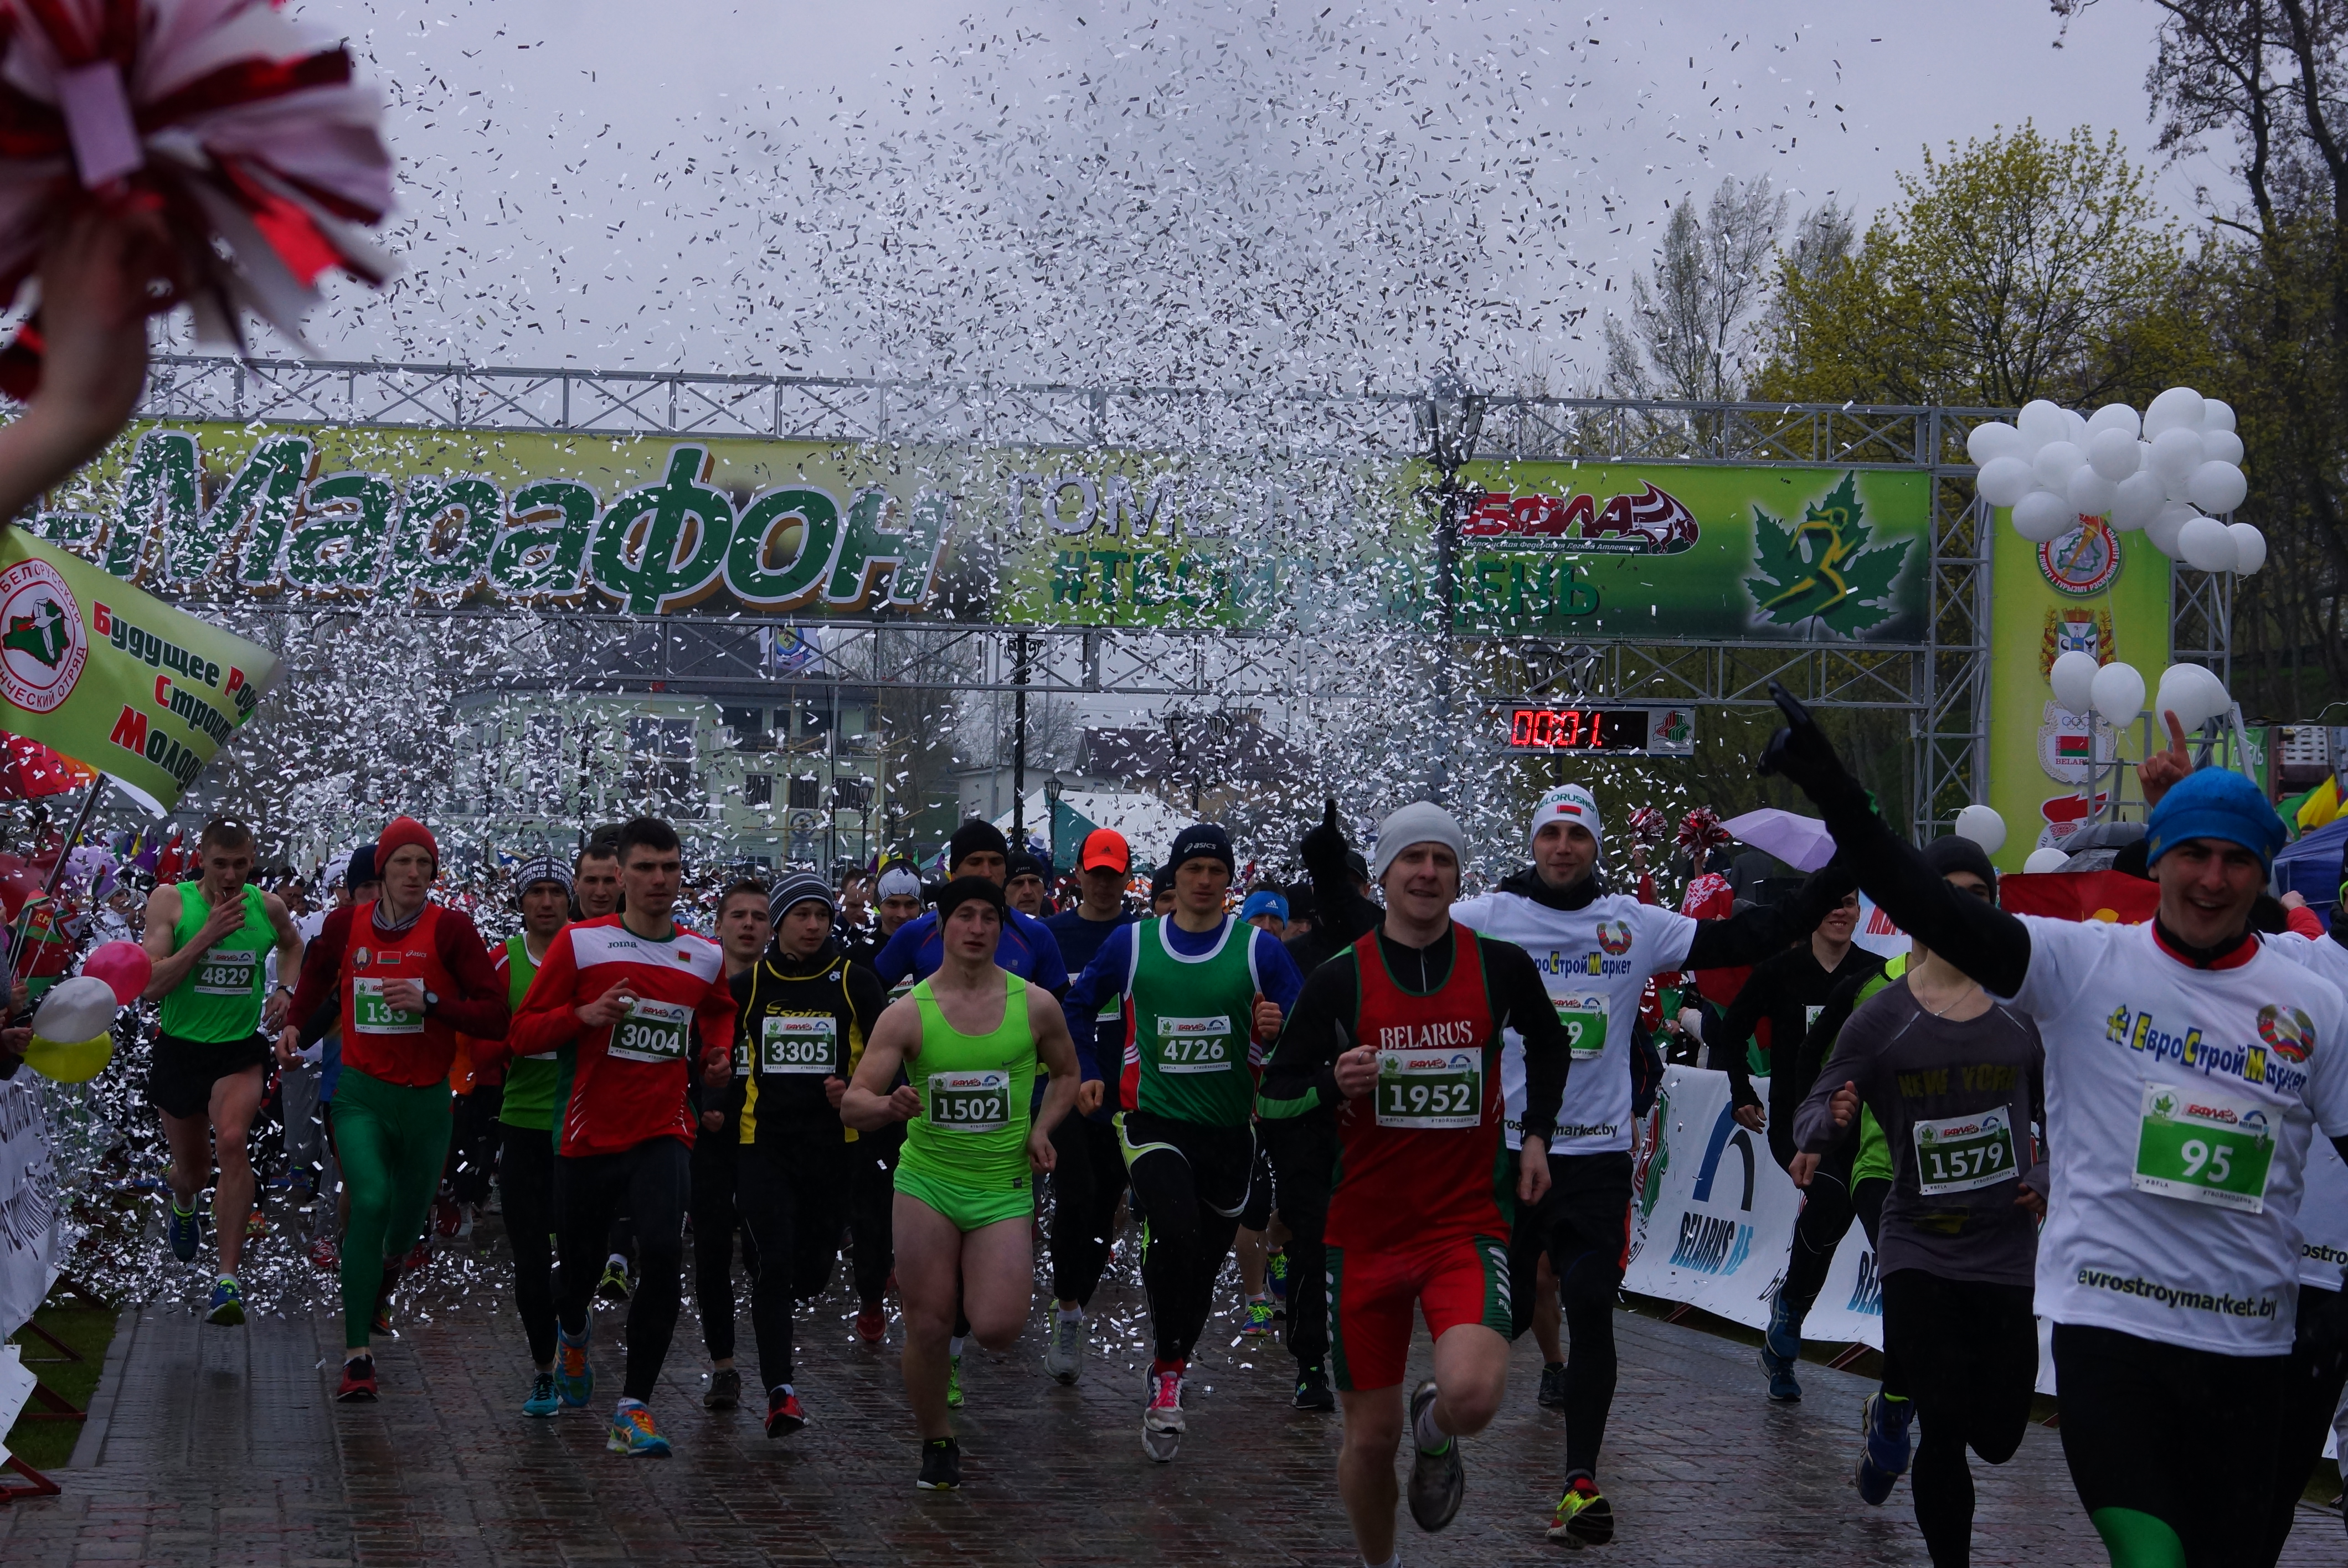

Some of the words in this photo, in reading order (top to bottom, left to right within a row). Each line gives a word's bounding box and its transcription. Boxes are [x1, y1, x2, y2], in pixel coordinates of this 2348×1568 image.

[1462, 493, 1634, 538] БФЛА
[2039, 554, 2053, 578] СПОРТУ
[2056, 580, 2087, 592] ТУРЫЗМУ
[93, 600, 220, 688] Будущее
[58, 647, 86, 698] ОТРЯД
[201, 967, 250, 985] 4829
[621, 1024, 680, 1054] 3004
[771, 1041, 828, 1062] 3305
[1164, 1039, 1224, 1061] 4726
[1379, 1020, 1473, 1049] BELARUS
[2130, 1011, 2307, 1094] ЕвроСтройМаркет
[1390, 1084, 1471, 1112] 1952
[1897, 1067, 1949, 1097] NEW
[1961, 1063, 2020, 1093] YORK
[939, 1097, 1001, 1121] 1502
[1930, 1142, 2004, 1179] 1579
[2181, 1139, 2233, 1183] 95
[1669, 1211, 1735, 1275] BELARUS
[2077, 1268, 2277, 1321] evrostroymarket.by
